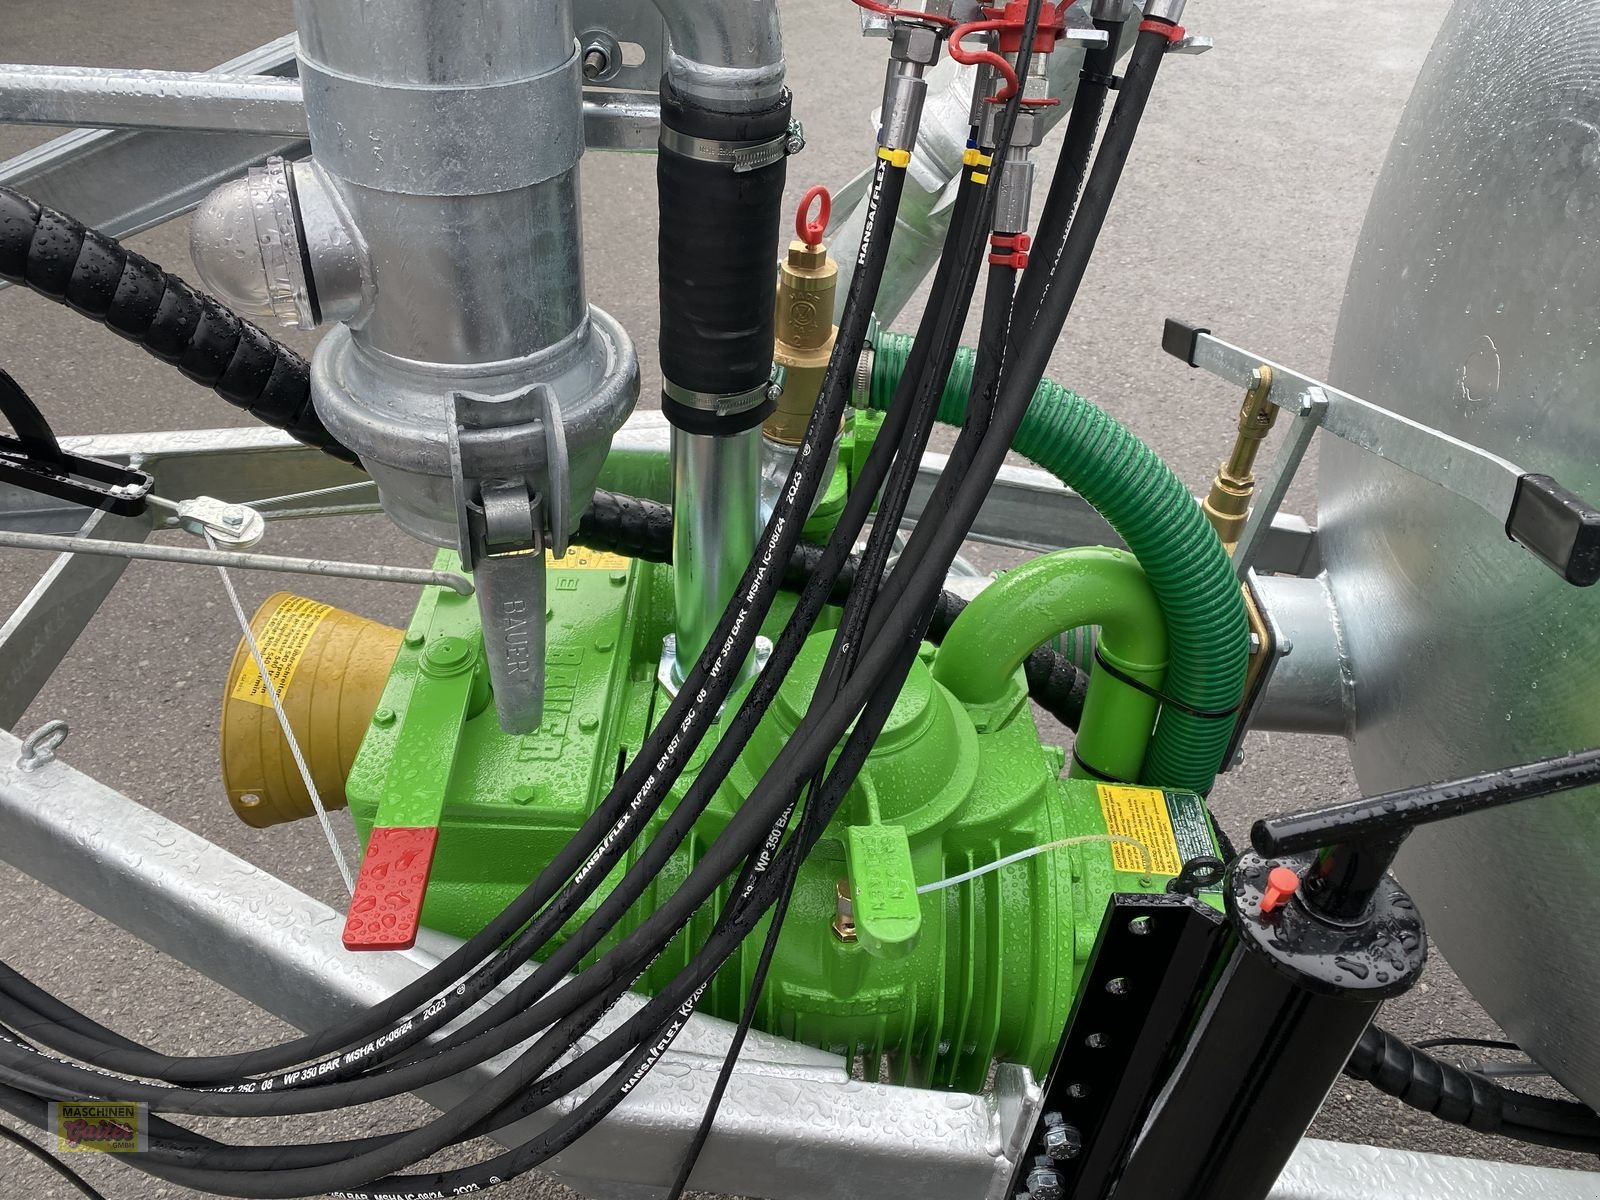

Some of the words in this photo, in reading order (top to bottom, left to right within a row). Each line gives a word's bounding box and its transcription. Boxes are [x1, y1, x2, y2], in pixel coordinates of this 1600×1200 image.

[503, 600, 530, 676] BAUER
[629, 775, 656, 810] KP208
[656, 754, 670, 772] EN
[666, 735, 681, 755] 857
[680, 708, 696, 733] 2SC
[696, 688, 707, 704] 08
[709, 659, 723, 679] WP
[720, 634, 735, 660] 350
[731, 608, 748, 637] BAR
[746, 564, 767, 603] MSHA
[786, 471, 802, 505] 2Q23
[263, 651, 274, 664] 540
[270, 654, 280, 668] 540
[280, 649, 290, 662] 540
[259, 669, 274, 694] trin
[272, 663, 283, 680] rpm.
[517, 647, 585, 762] BAUER
[754, 851, 771, 872] WP
[766, 829, 782, 851] 350
[776, 802, 795, 828] BA
[678, 982, 708, 1017] KP208
[261, 1078, 273, 1091] 08
[283, 1070, 300, 1086] WP
[301, 1066, 318, 1081] 350
[318, 1058, 340, 1076] BAR
[344, 1042, 375, 1064] MSHA
[422, 998, 447, 1021] 2Q23
[453, 1183, 480, 1195] 2Q23
